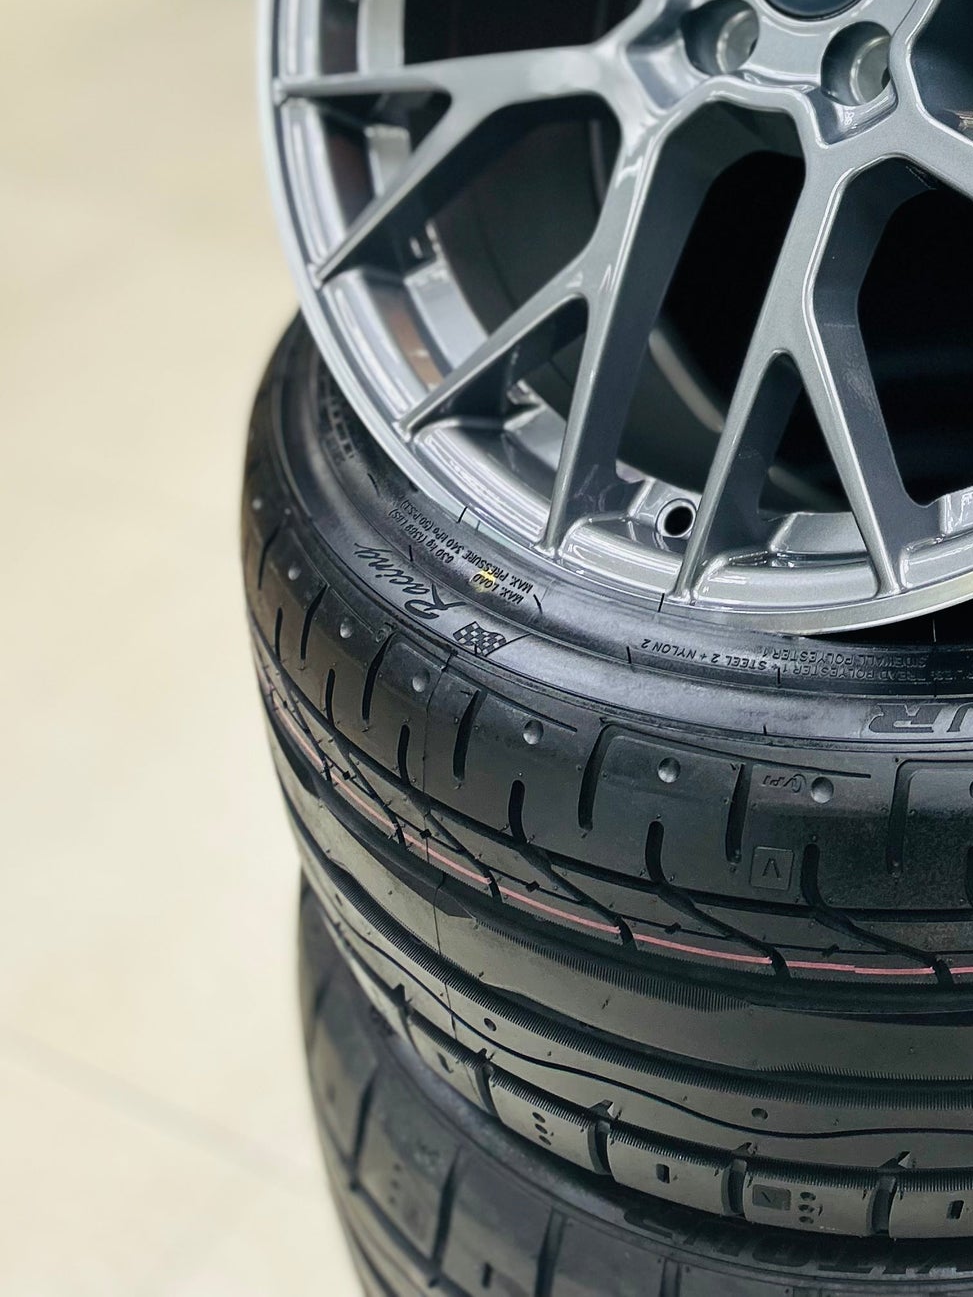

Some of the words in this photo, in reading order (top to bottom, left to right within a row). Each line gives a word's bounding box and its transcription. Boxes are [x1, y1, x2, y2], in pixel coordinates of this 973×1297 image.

[446, 538, 465, 555] 340
[462, 549, 510, 582] PRESSURE
[354, 543, 468, 620] Racing
[472, 573, 500, 592] LOAD
[510, 575, 533, 594] MAX.
[501, 586, 525, 605] MAX.
[641, 638, 651, 649] 2
[653, 641, 697, 660] NYLON
[725, 655, 767, 671] STEEL
[772, 649, 854, 665] POLYESTER
[858, 654, 929, 668] SIDEWALL
[792, 665, 875, 681] POLYESTER
[879, 670, 927, 682] TREAD
